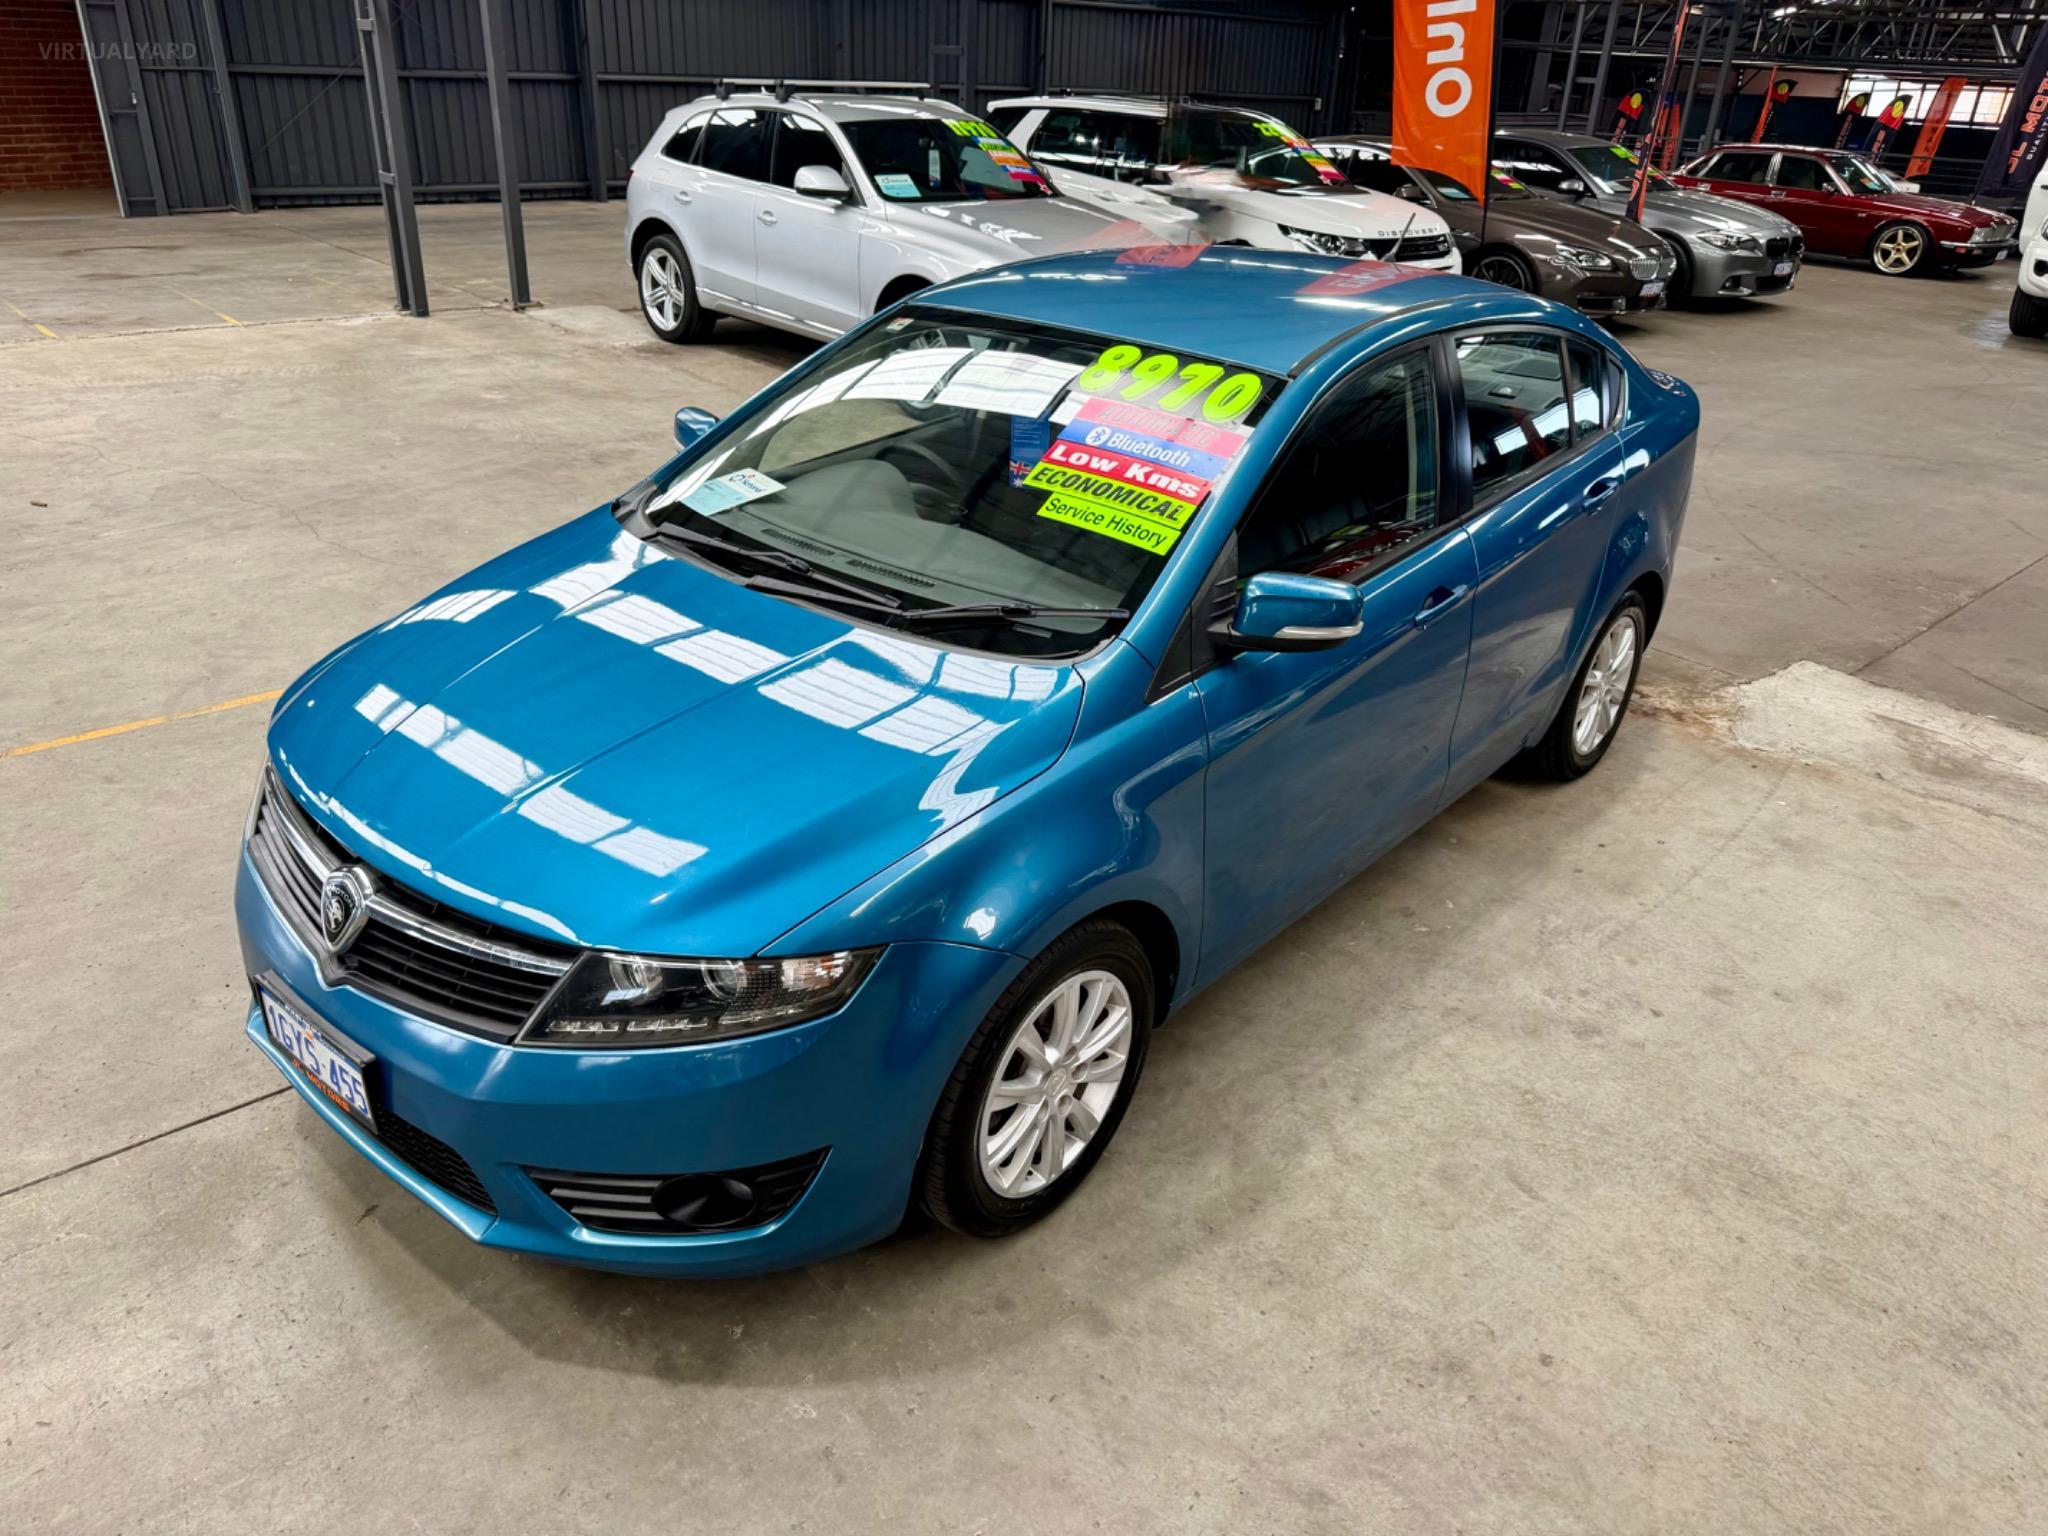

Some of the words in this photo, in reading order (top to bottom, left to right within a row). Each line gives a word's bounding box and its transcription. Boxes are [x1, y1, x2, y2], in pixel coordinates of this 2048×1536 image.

[2020, 69, 2048, 133] MOT
[1109, 432, 1191, 467] Bluetooth
[1032, 467, 1184, 522] ECONOMICAL
[1045, 498, 1105, 526] Service
[1108, 517, 1168, 548] History
[329, 1058, 370, 1115] 455
